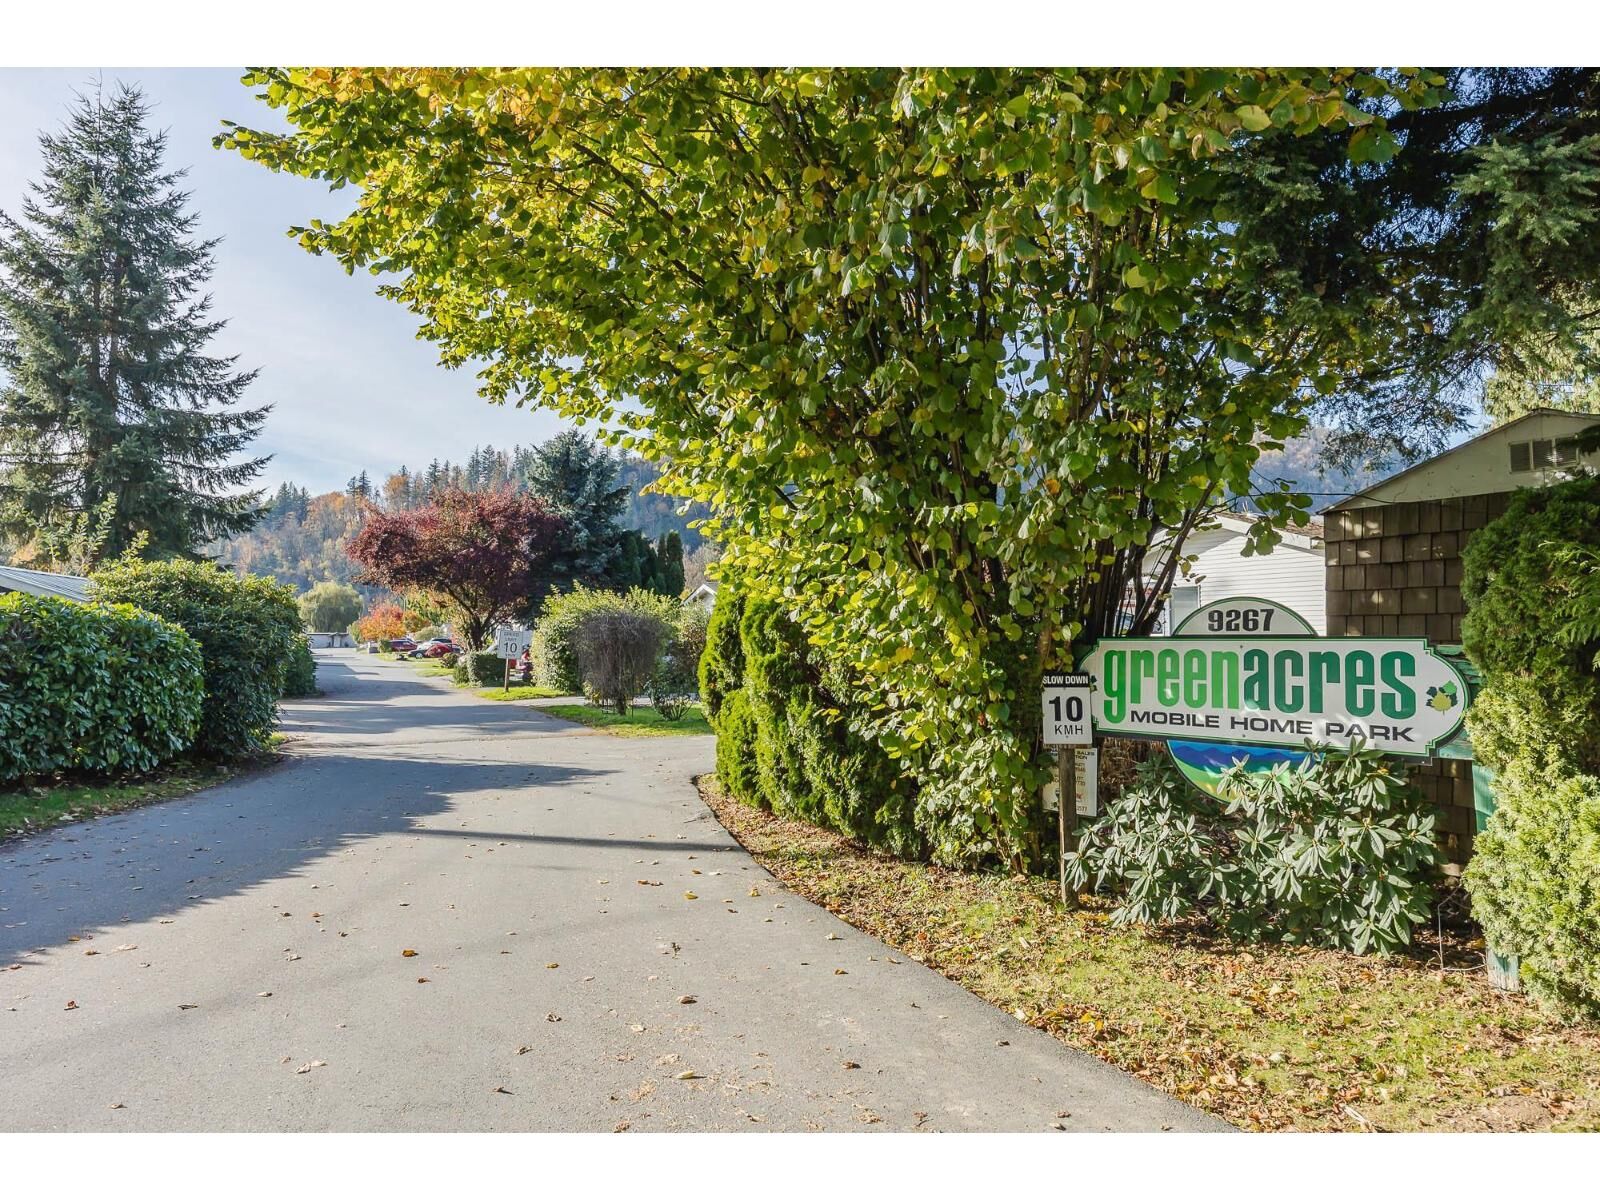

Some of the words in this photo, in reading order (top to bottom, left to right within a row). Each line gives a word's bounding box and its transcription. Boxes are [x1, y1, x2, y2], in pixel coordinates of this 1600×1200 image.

[1207, 608, 1275, 632] 9267
[504, 642, 517, 653] 10
[1042, 675, 1064, 685] SLOW
[1065, 675, 1089, 685] DOWN
[1103, 648, 1417, 724] greenacres
[1048, 696, 1083, 722] 10
[1054, 724, 1083, 735] KMH
[1130, 710, 1220, 729] MOBILE
[1230, 717, 1313, 735] HOME
[1325, 722, 1415, 742] PARK
